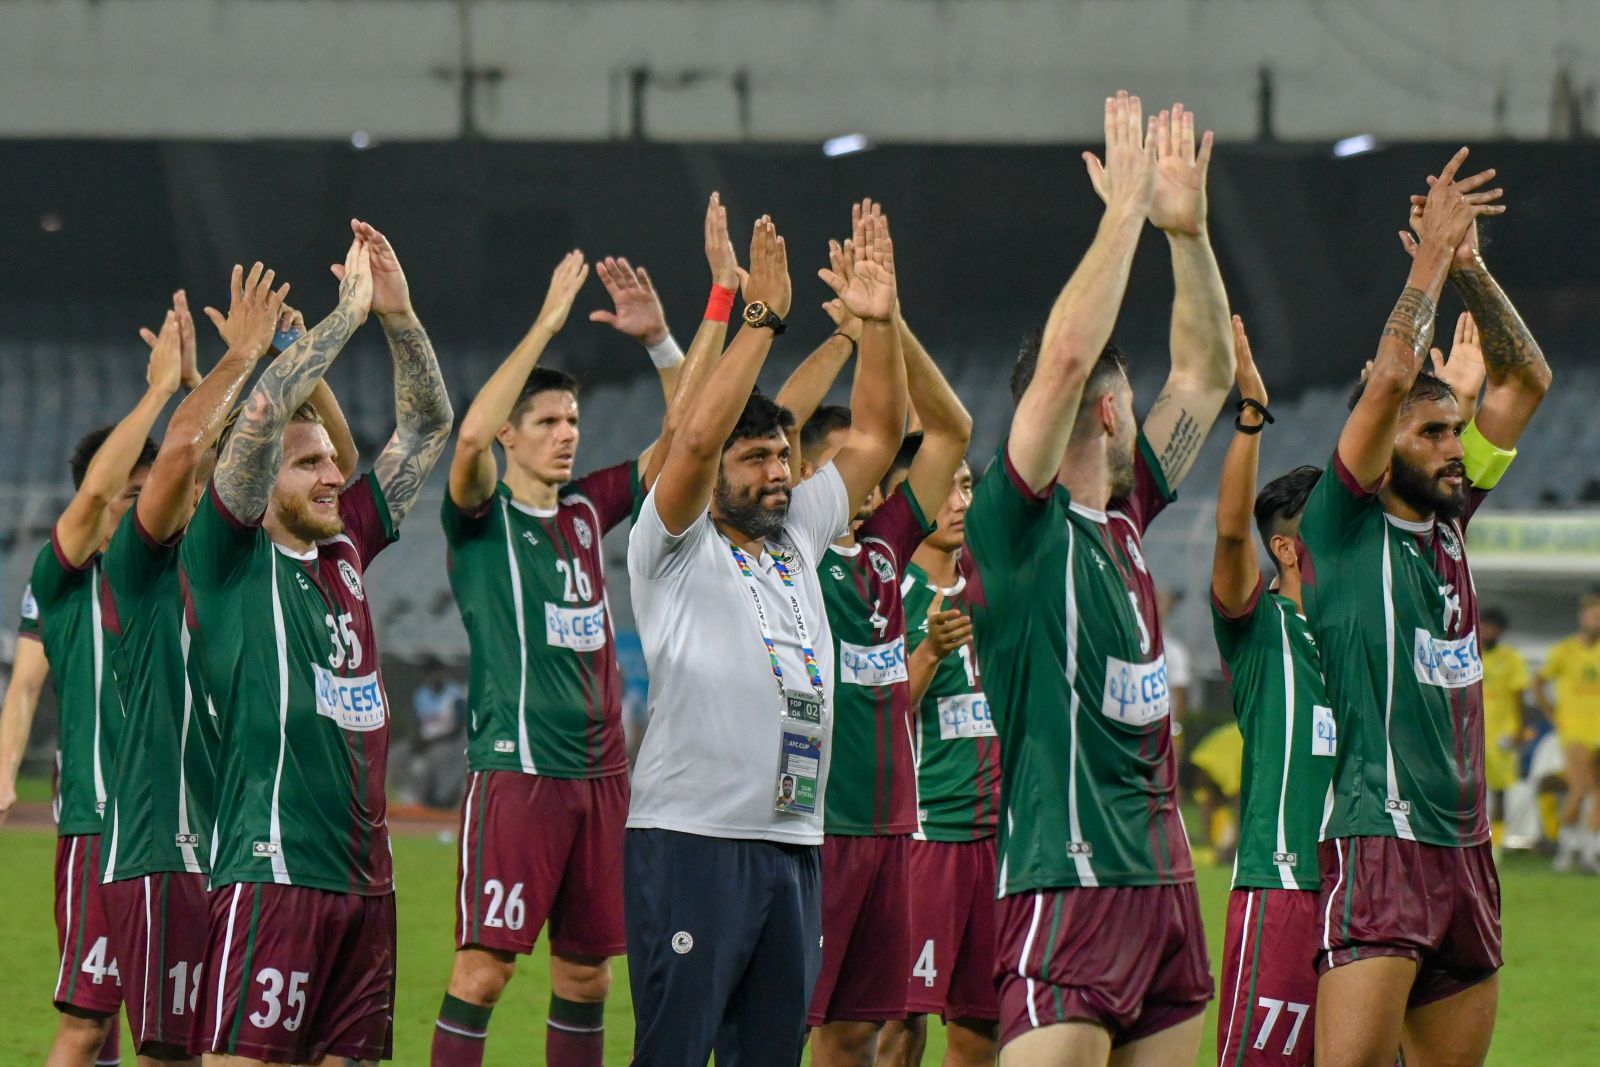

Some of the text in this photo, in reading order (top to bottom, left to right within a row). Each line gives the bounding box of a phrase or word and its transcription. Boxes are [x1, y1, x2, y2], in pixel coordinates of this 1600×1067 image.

[555, 557, 592, 602] 26
[325, 612, 362, 670] 35
[805, 703, 819, 717] 02
[1141, 666, 1167, 704] CES
[483, 879, 526, 931] 26
[248, 967, 310, 1032] 35
[1253, 996, 1310, 1055] 77
